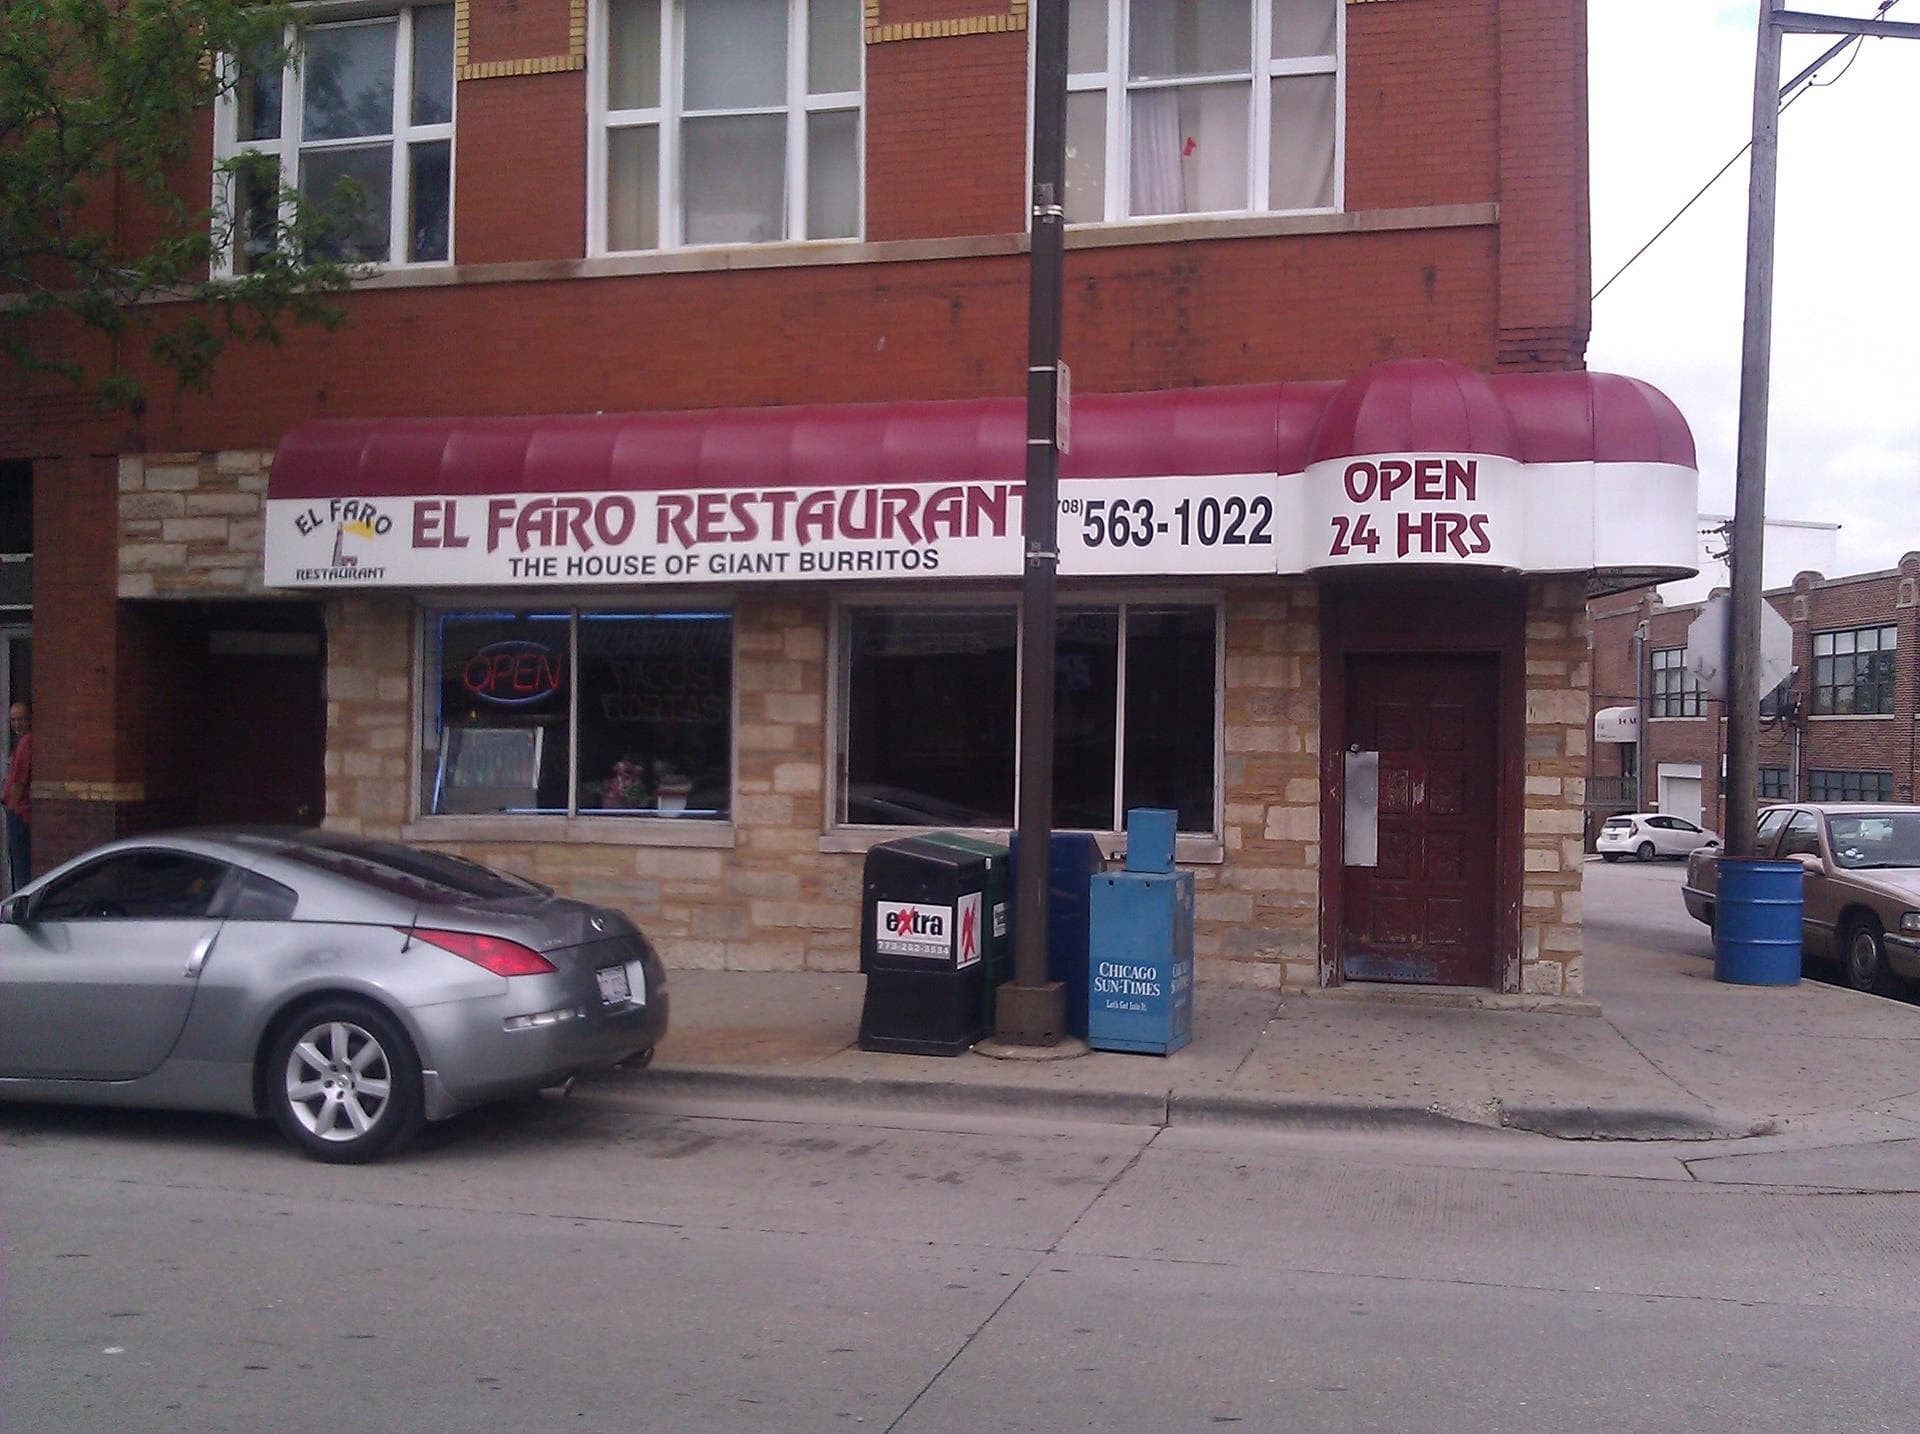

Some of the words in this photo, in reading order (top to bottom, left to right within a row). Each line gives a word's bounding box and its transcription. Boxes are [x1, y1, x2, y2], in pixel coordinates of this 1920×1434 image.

[1343, 459, 1477, 504] OPEN
[295, 509, 323, 536] EL
[329, 499, 393, 535] FARO
[412, 499, 470, 549] EL
[487, 494, 637, 554] FARO
[1082, 496, 1273, 548] 563-1022
[1329, 514, 1381, 556] 24
[1396, 511, 1491, 559] HRS
[296, 567, 387, 581] RESTAURANT
[508, 556, 558, 578] THE
[566, 554, 657, 577] HOUSE
[665, 554, 700, 576] OF
[708, 551, 790, 575] GIANT
[799, 548, 940, 573] BURRITOS
[464, 653, 563, 692] OPEN
